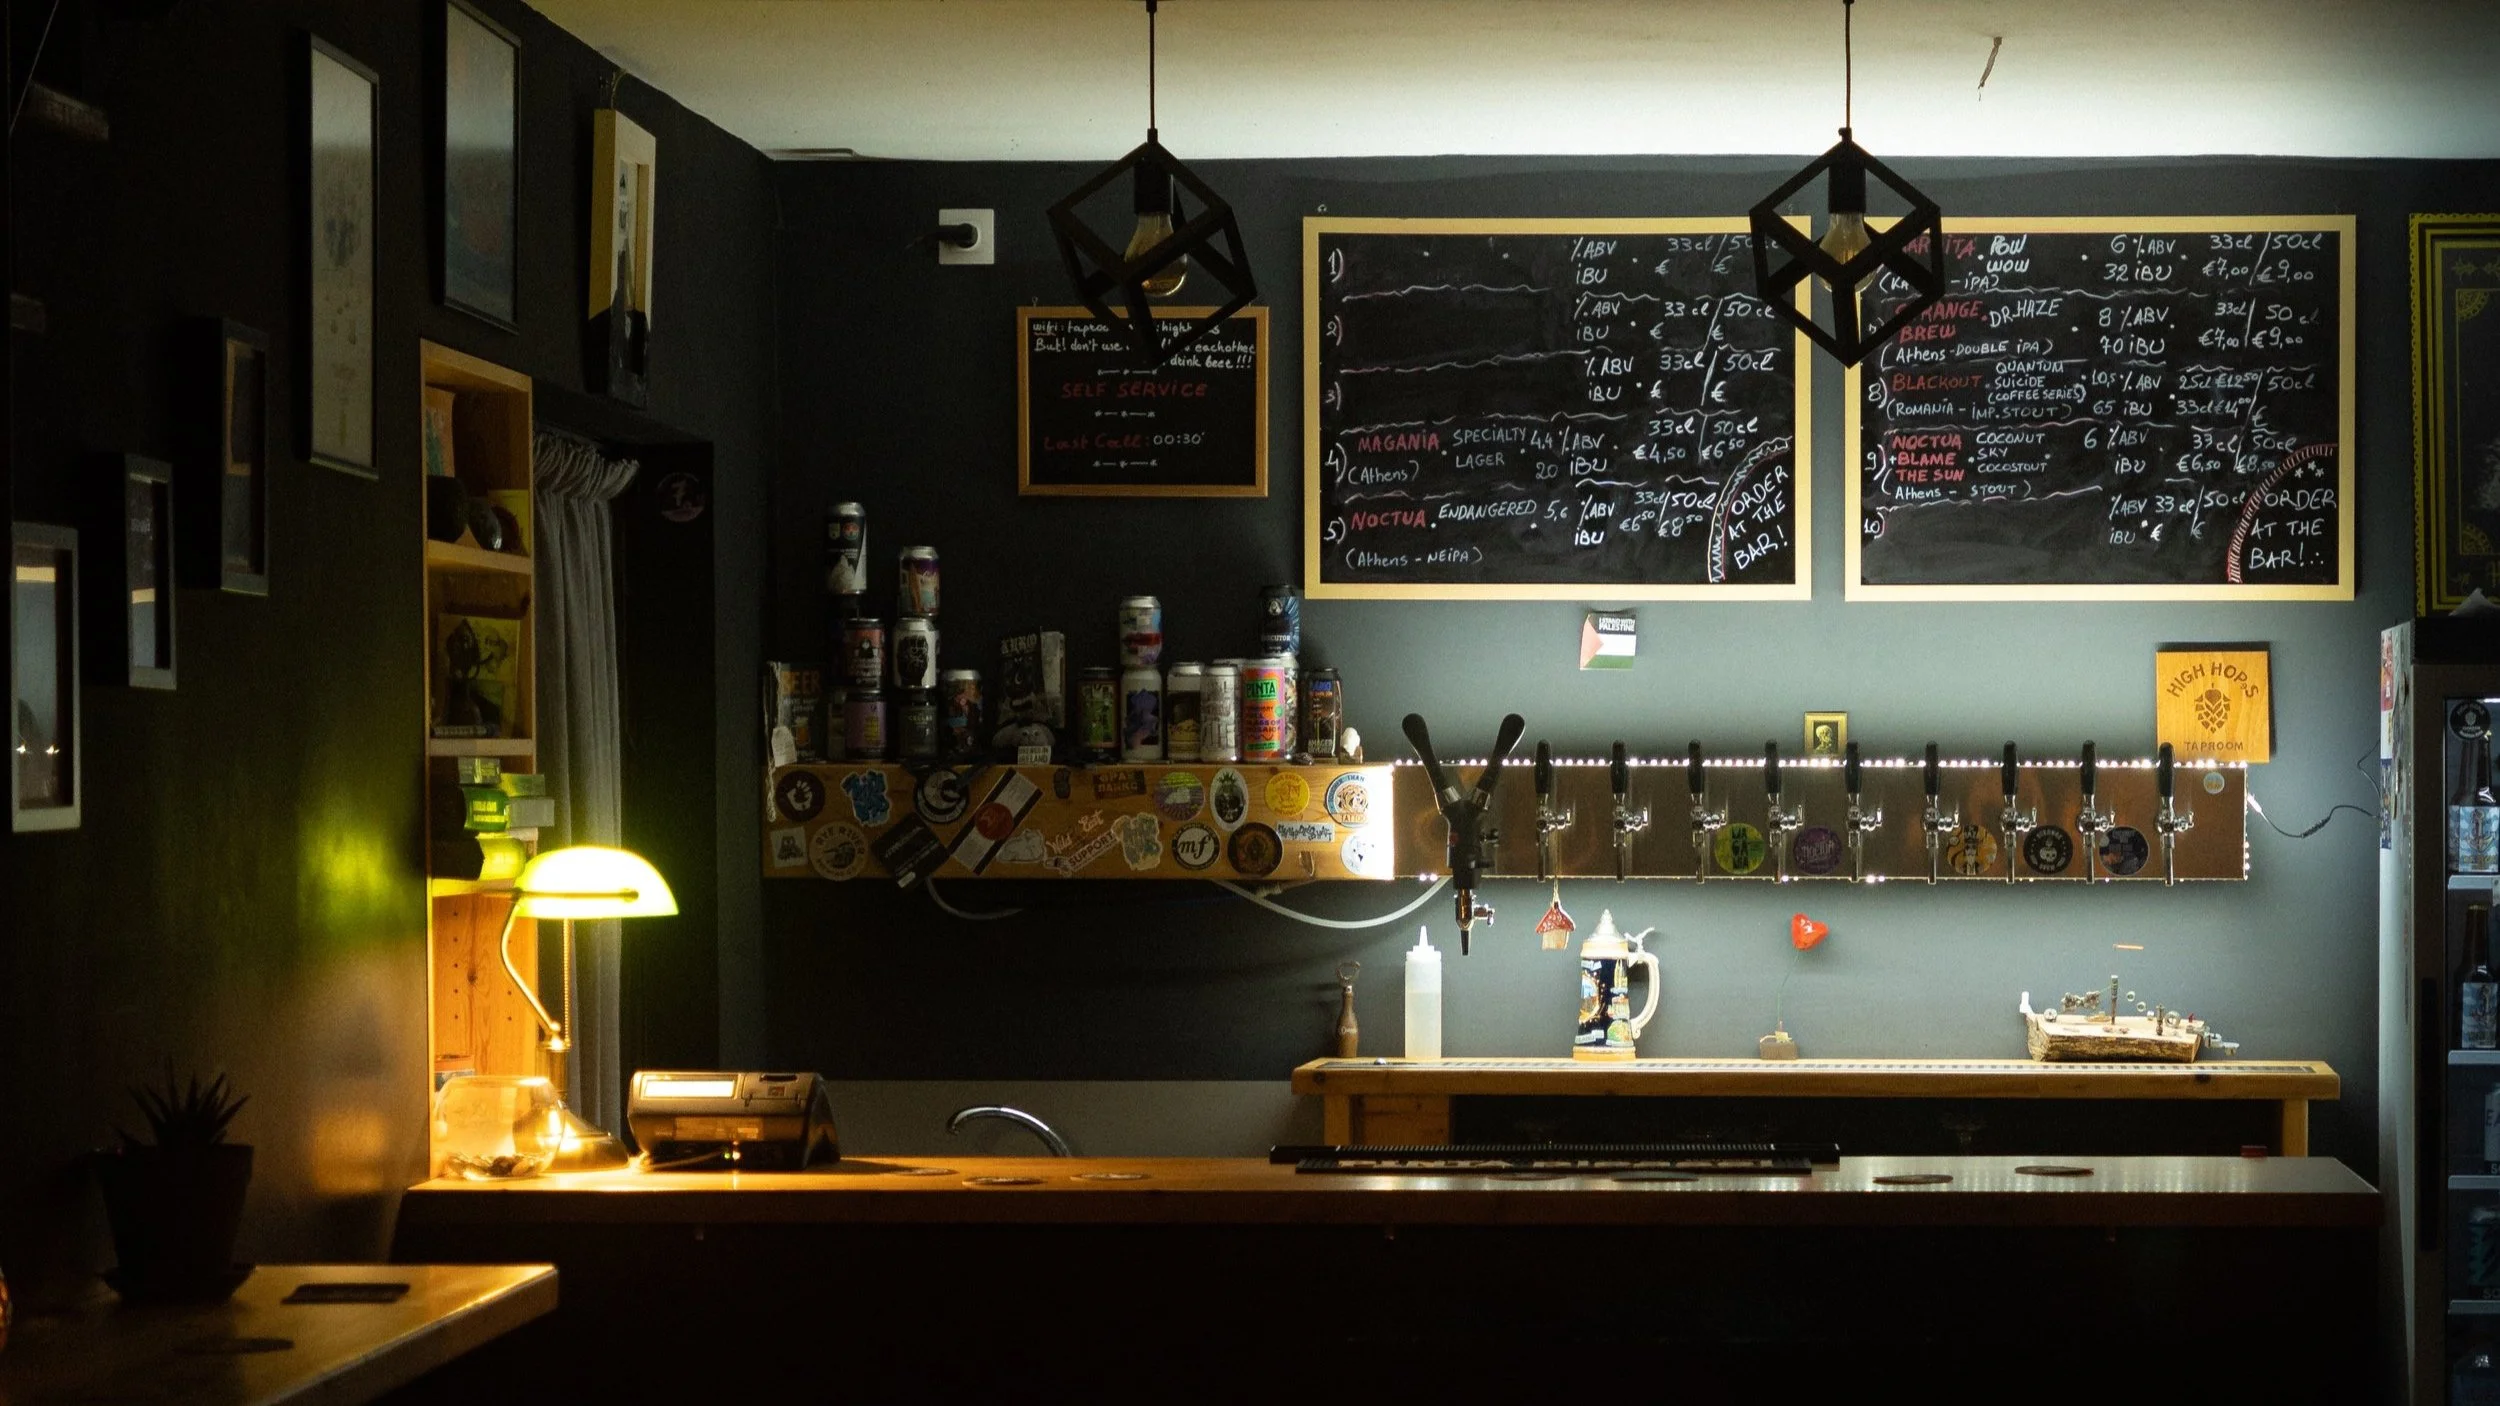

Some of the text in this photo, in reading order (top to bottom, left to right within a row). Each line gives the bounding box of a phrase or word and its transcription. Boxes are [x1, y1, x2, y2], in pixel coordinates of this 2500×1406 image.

[2110, 234, 2127, 253] 6
[1328, 248, 1344, 283] 1)
[1986, 258, 2030, 273] WOW
[2103, 263, 2129, 282] 32
[2099, 307, 2112, 327] 8
[1326, 315, 1342, 346] 2)
[1900, 325, 1956, 343] BREW
[2100, 335, 2124, 355] 70
[1995, 360, 2064, 375] QUANTUM
[1061, 381, 1108, 399] SELF
[1868, 377, 1888, 409] 8)
[1891, 373, 1984, 391] BLACKOUT
[1326, 381, 1342, 411] 3)
[2093, 400, 2113, 414] 65
[1891, 434, 1963, 450] NOCTUA
[1976, 432, 2046, 445] COCONUT
[2084, 428, 2097, 449] 6
[1325, 442, 1347, 483] 4)
[1456, 452, 1505, 468] LAGER
[1535, 462, 1559, 480] 20
[1864, 443, 1887, 481] 9)
[1977, 447, 2008, 461] SKY
[1895, 462, 2048, 482] THE SUN COCOSTOUT
[1731, 464, 1789, 516] ORDER
[2264, 489, 2337, 511] ORDER
[1350, 511, 1426, 531] NOCTUA
[1438, 500, 1537, 519] ENDANGERED
[1728, 491, 1787, 541] AT THE
[1863, 511, 1885, 540] 10)
[1323, 516, 1346, 545] 5)
[2251, 519, 2325, 538] AT THE
[1599, 623, 1635, 632] PALESTINE
[2166, 662, 2259, 699] HIGH HOPS
[1068, 831, 1113, 867] SUPPORT
